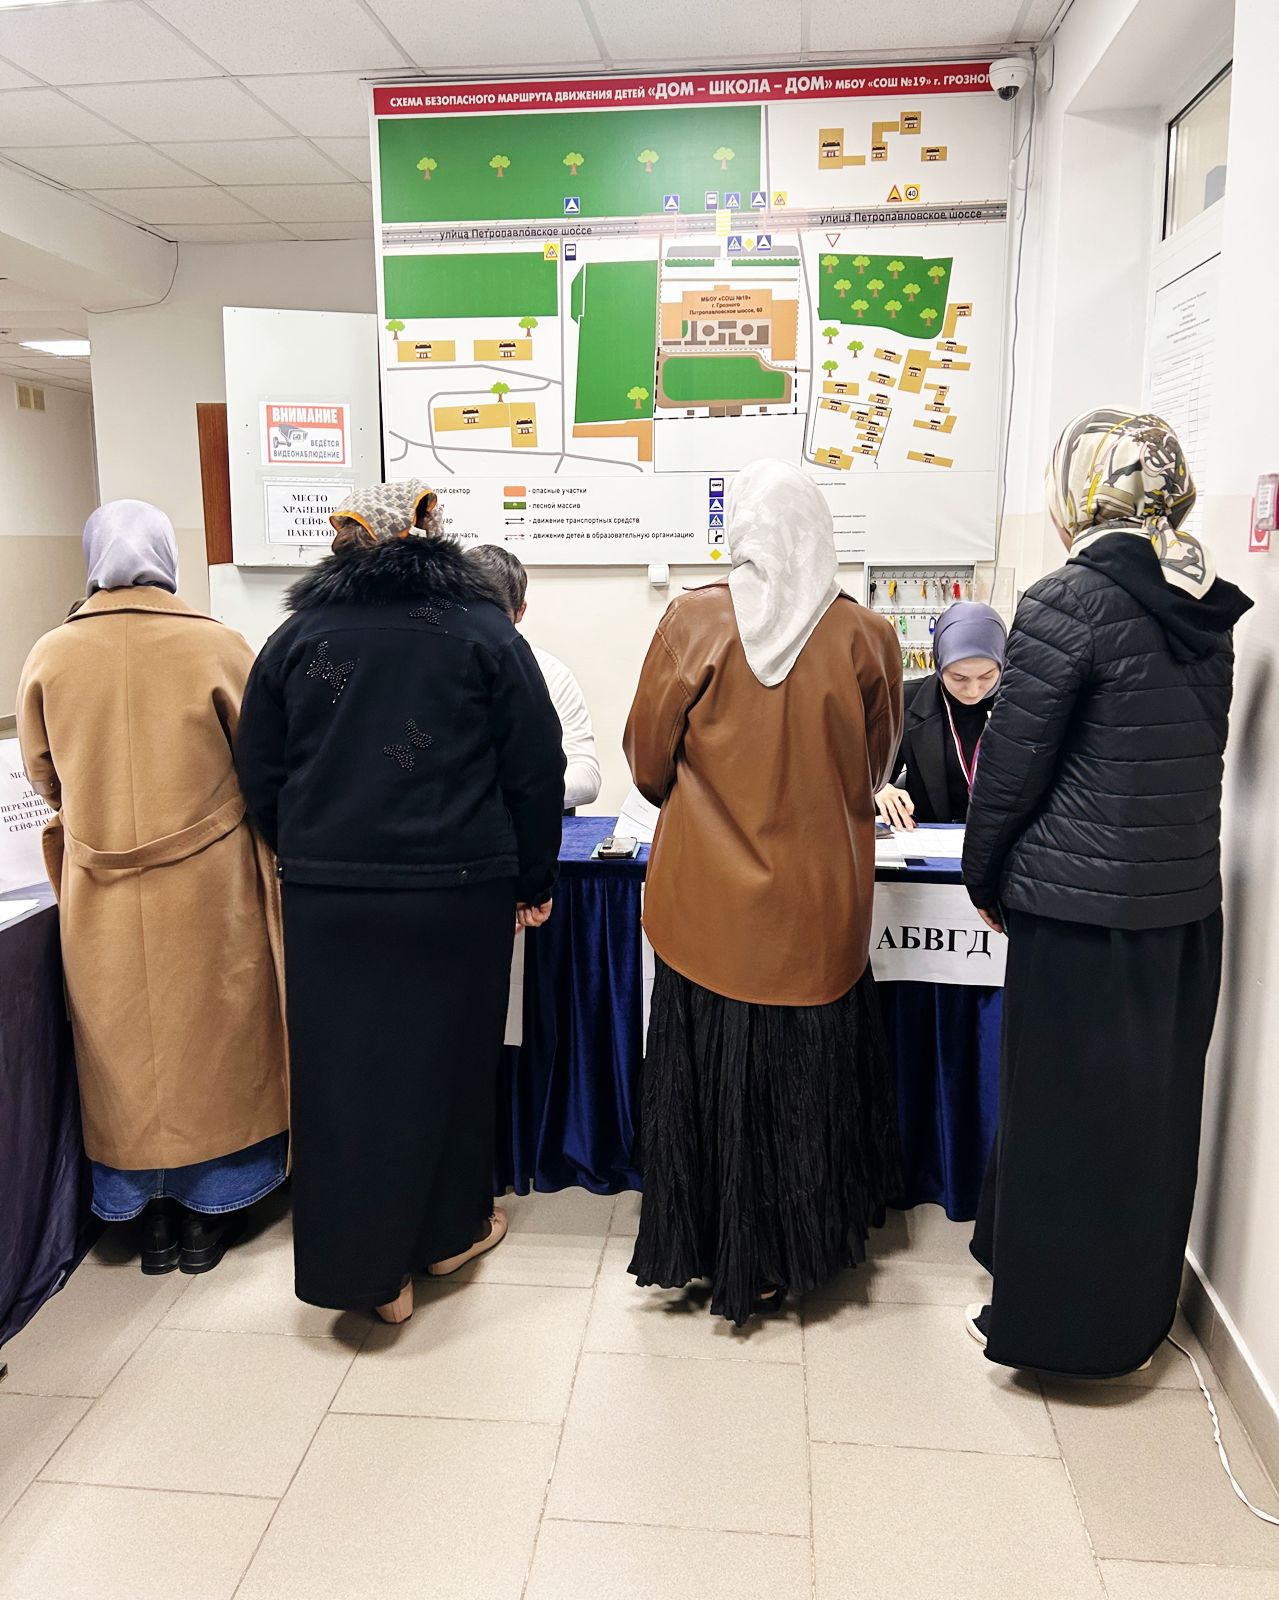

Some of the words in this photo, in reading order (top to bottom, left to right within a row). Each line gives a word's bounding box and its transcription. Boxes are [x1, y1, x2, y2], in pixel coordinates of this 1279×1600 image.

[390, 97, 423, 107] СХЕМА
[425, 94, 496, 106] БЕЗОПАСНОГО
[497, 92, 553, 104] МАРШРУТА
[555, 90, 612, 102] ДВИЖЕНИЯ
[614, 86, 646, 100] ДЕТЕЙ
[649, 82, 694, 100] «ДОМ
[709, 79, 770, 95] ШКОЛА
[784, 76, 832, 94] ДОМ»
[835, 78, 866, 90] МБОУ
[868, 77, 898, 88] «СОШ
[900, 76, 932, 86] №19»
[944, 74, 990, 85] ГРОЗНОГ
[820, 214, 850, 224] улица
[854, 211, 946, 224] Петропавловское
[949, 210, 982, 220] шоссе
[440, 230, 469, 240] улица
[472, 227, 558, 240] Петропавловское
[561, 227, 592, 236] шоссе
[272, 407, 338, 424] ВНИМАНИЕ
[273, 450, 340, 458] ВИДЕОНАБЛЮДЕНИЕ
[292, 494, 328, 502] МЕСТО
[294, 516, 327, 525] СЕЙФ-
[1, 799, 46, 813] ПЕРЕМЕЩ
[3, 808, 53, 823] БЮЛЛЕТЕН
[9, 818, 50, 832] СЕЙФ-ПА
[876, 926, 991, 960] АБВГД
